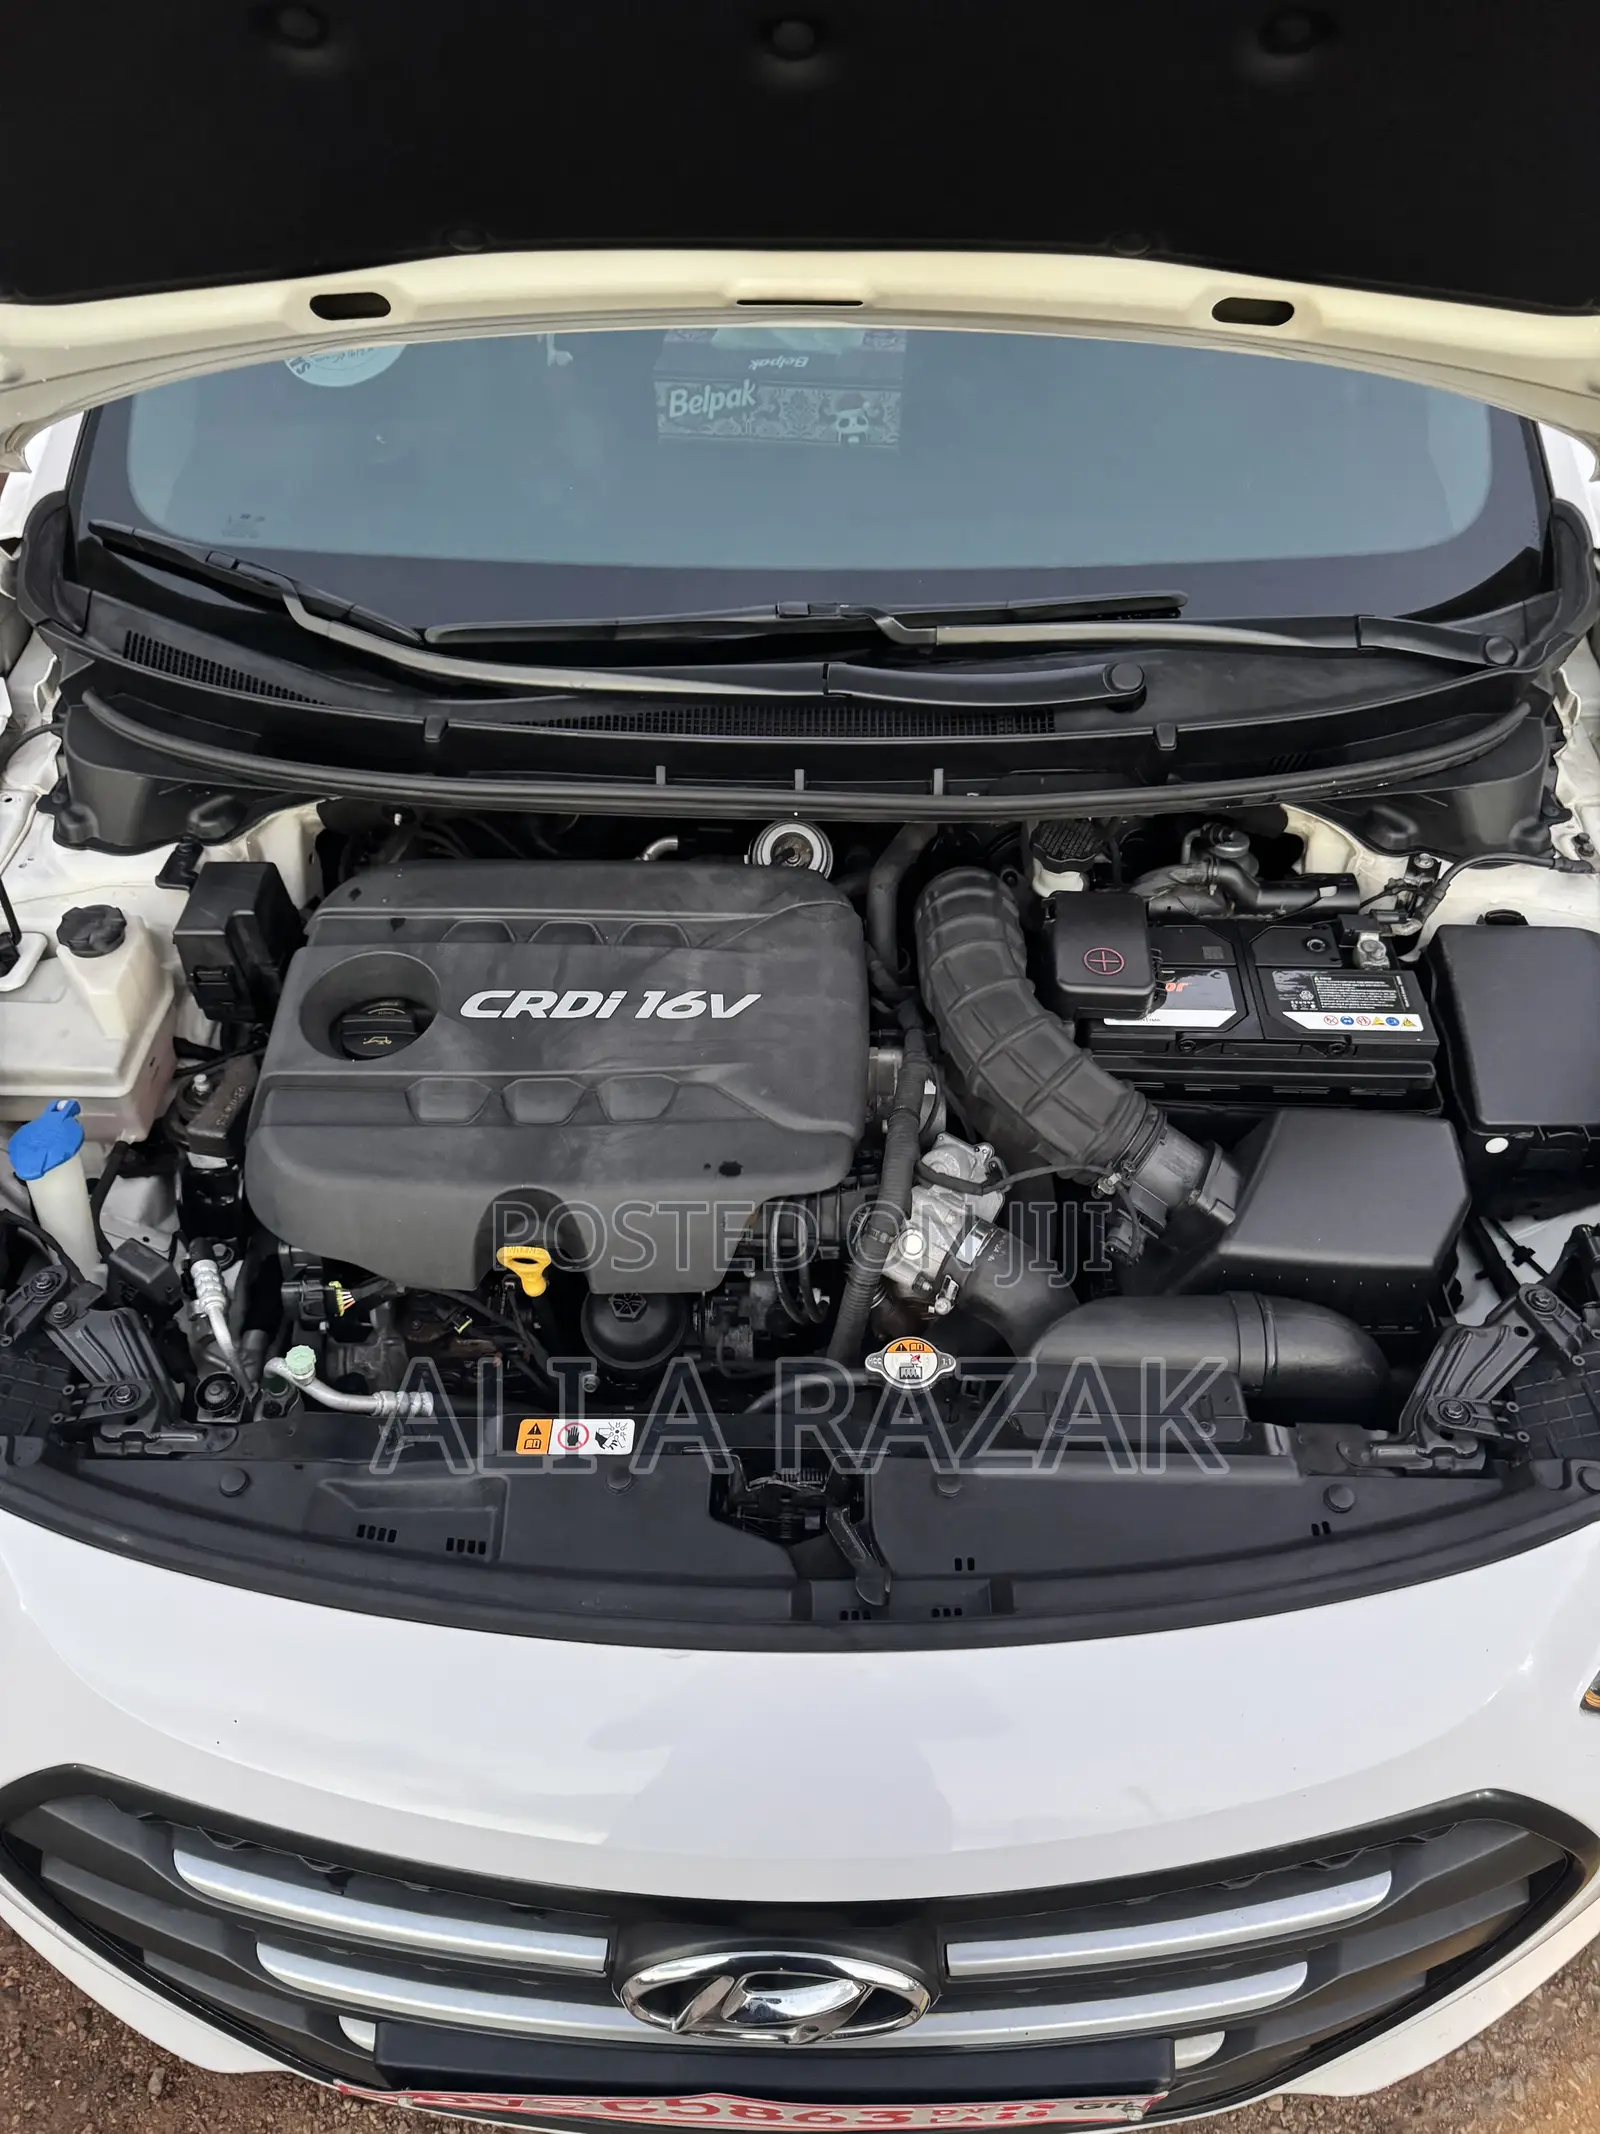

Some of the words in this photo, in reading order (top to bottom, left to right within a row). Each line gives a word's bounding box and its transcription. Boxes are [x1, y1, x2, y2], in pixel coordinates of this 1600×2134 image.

[750, 354, 809, 371] Belpak
[669, 378, 756, 420] Belpak
[460, 990, 628, 1019] CRDi
[635, 990, 762, 1019] 16V
